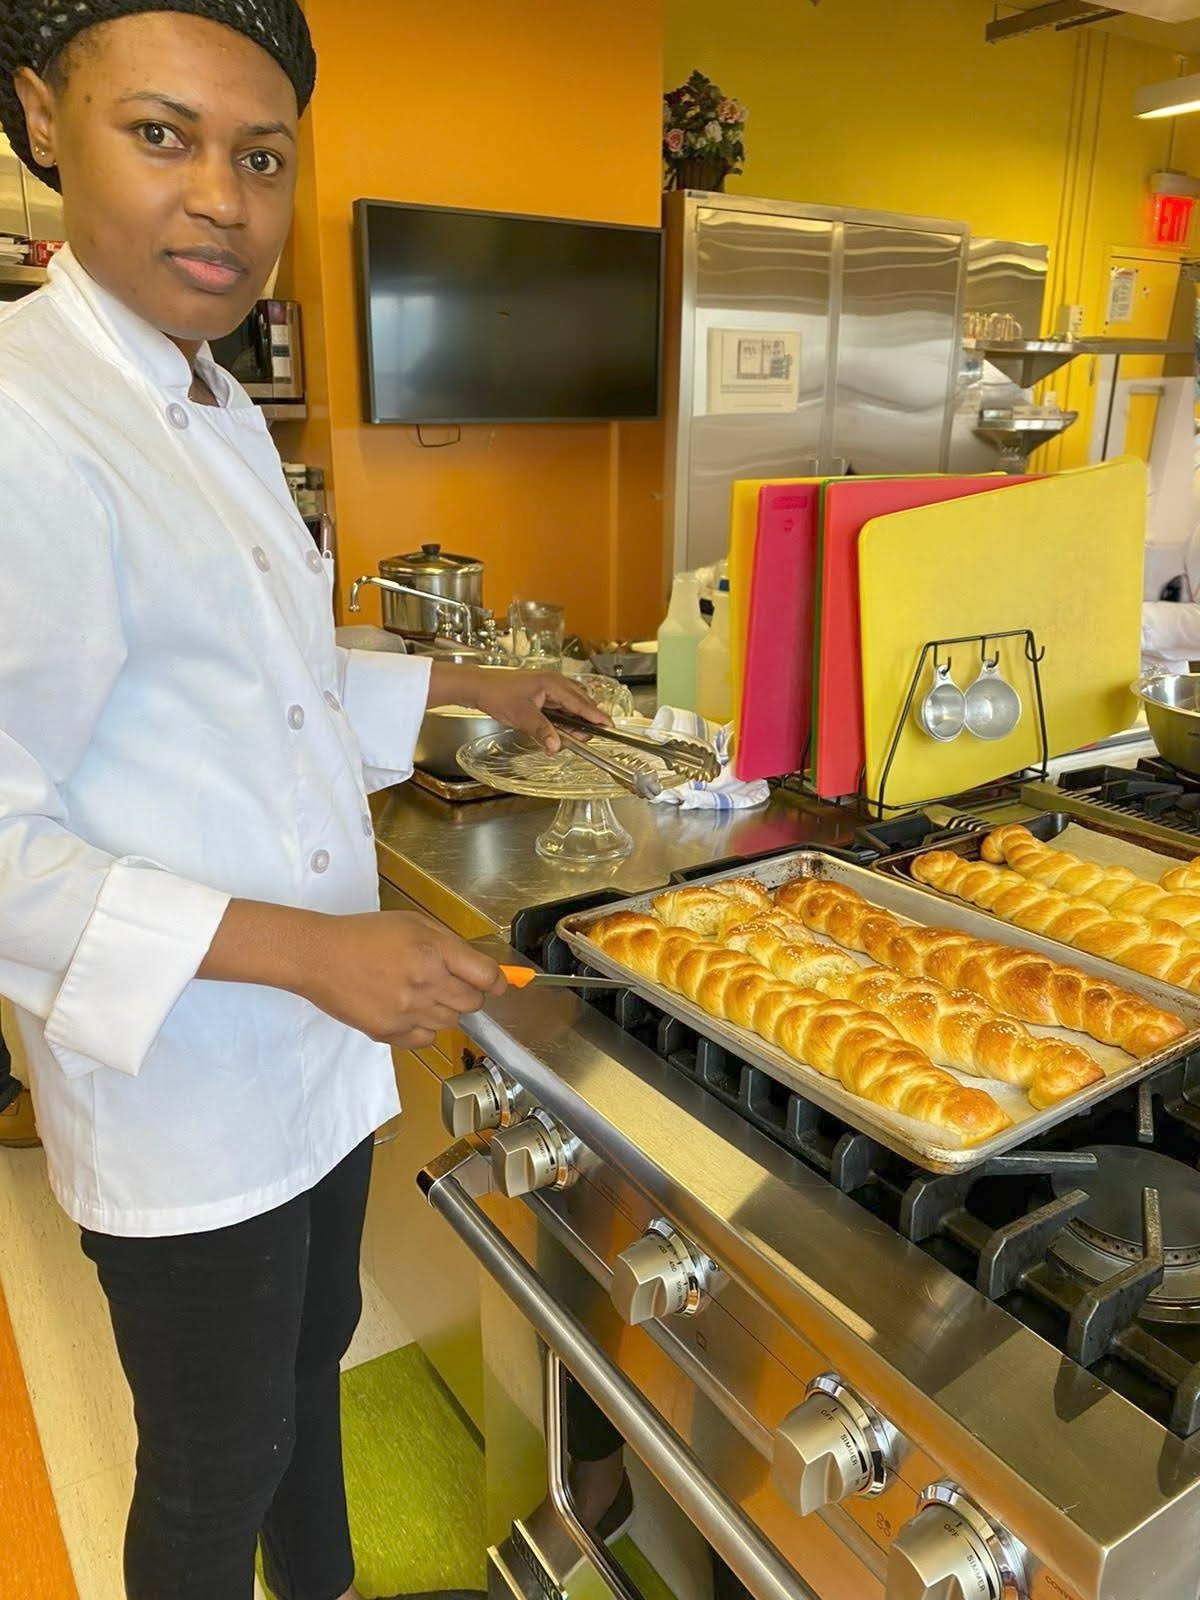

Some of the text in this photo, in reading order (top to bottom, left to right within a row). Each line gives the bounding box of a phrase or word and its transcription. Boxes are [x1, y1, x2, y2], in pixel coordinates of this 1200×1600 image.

[821, 1409, 834, 1422] OFF
[841, 1434, 857, 1466] SIMMER
[944, 1523, 959, 1537] OFF
[967, 1554, 985, 1592] SIMMER
